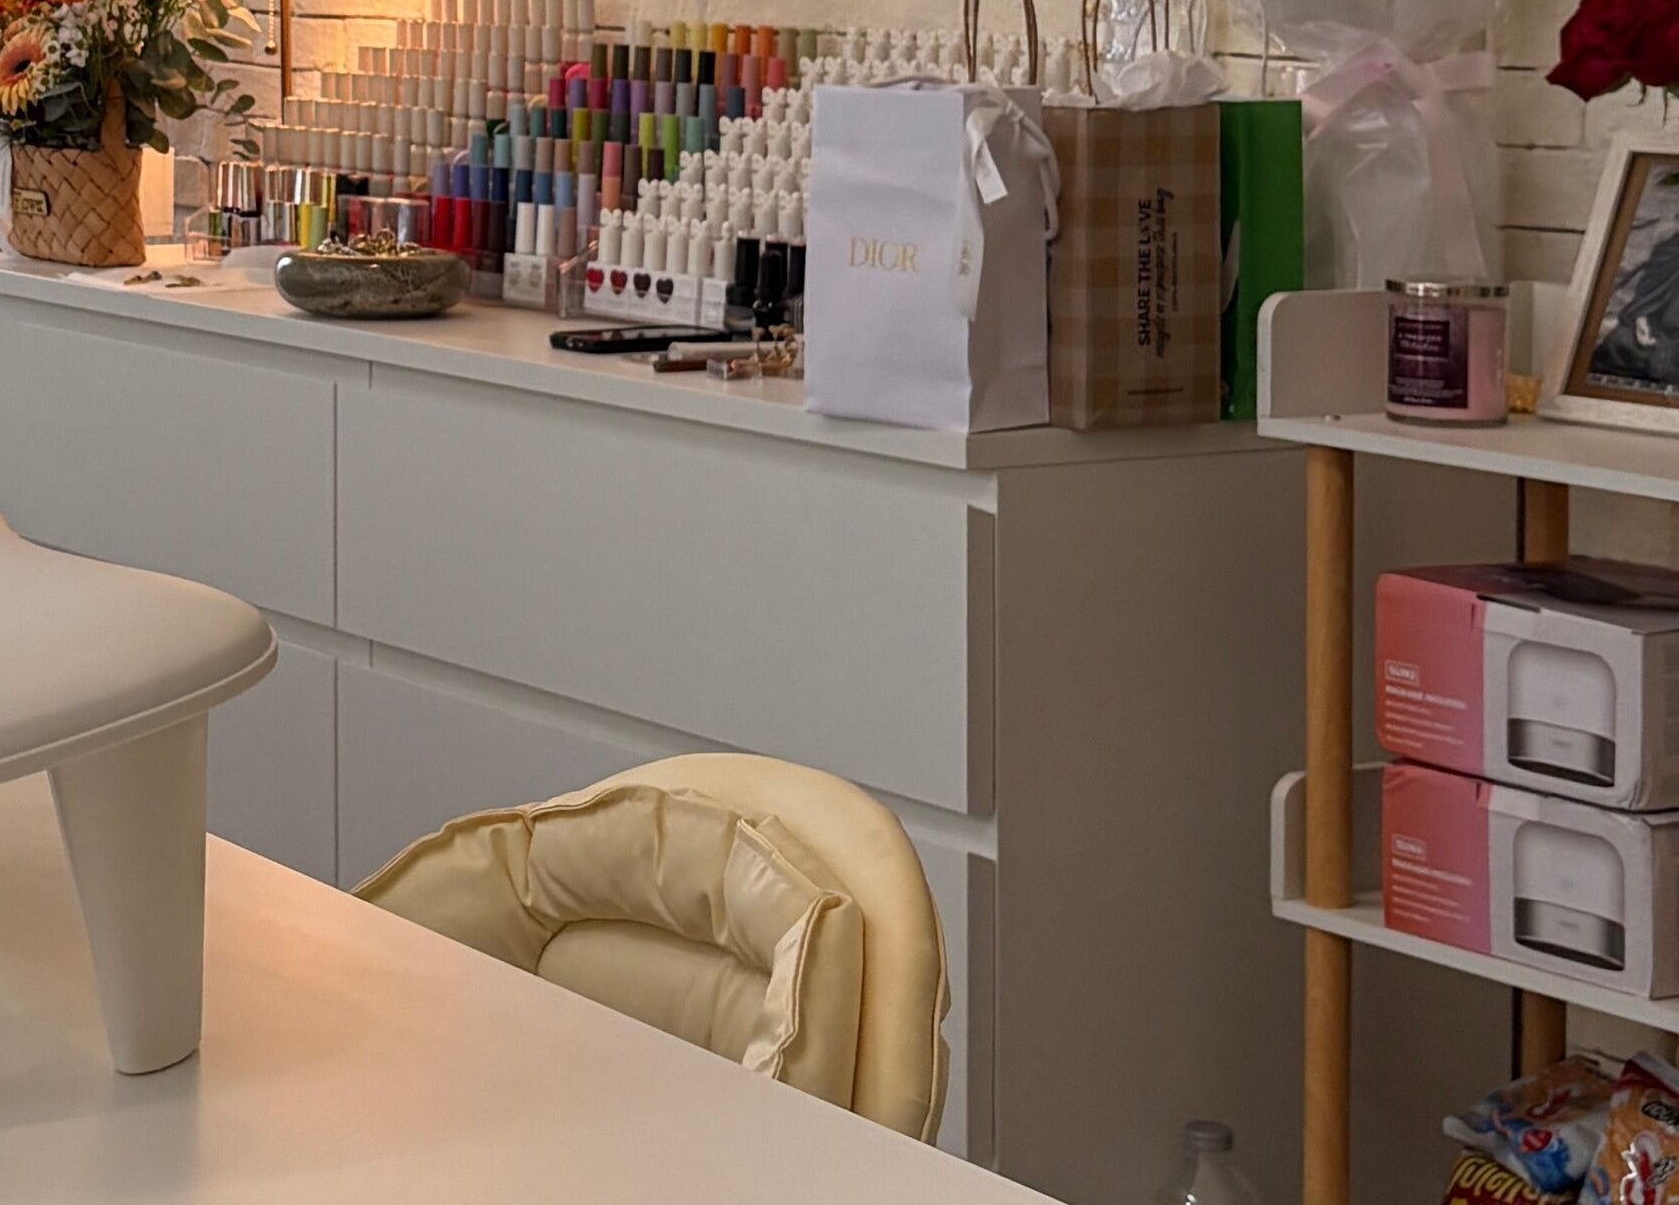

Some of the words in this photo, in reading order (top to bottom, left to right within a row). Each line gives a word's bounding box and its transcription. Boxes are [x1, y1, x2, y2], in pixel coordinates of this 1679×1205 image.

[848, 236, 920, 273] DIOR
[1136, 250, 1152, 284] THE
[1136, 288, 1152, 346] SHARE
